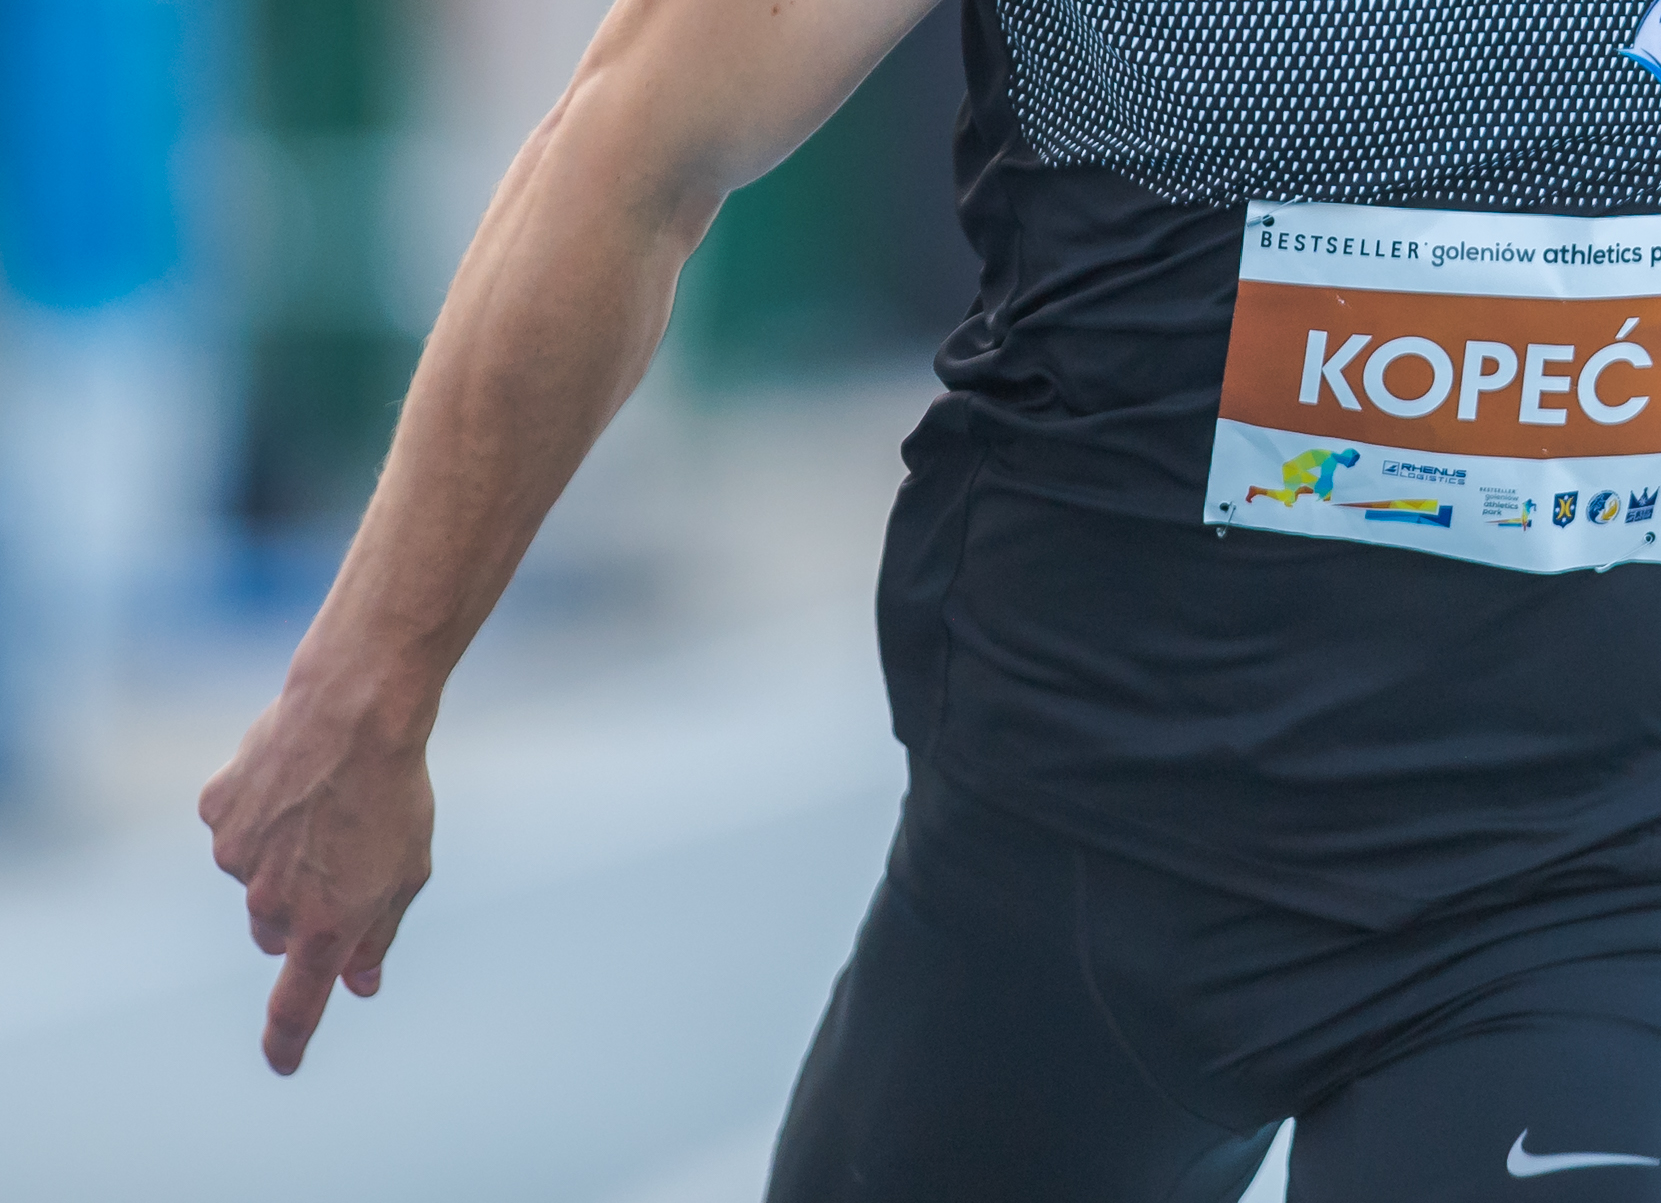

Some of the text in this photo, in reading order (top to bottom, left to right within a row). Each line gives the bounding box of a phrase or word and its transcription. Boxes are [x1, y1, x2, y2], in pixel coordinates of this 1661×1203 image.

[1260, 231, 1419, 259] BESTSELLER
[1431, 241, 1536, 267] goleniów
[1543, 242, 1642, 265] athletics
[1299, 317, 1653, 425] KOPEĆ
[1400, 472, 1466, 485] LOGISTICS
[1401, 462, 1467, 478] RHENUS
